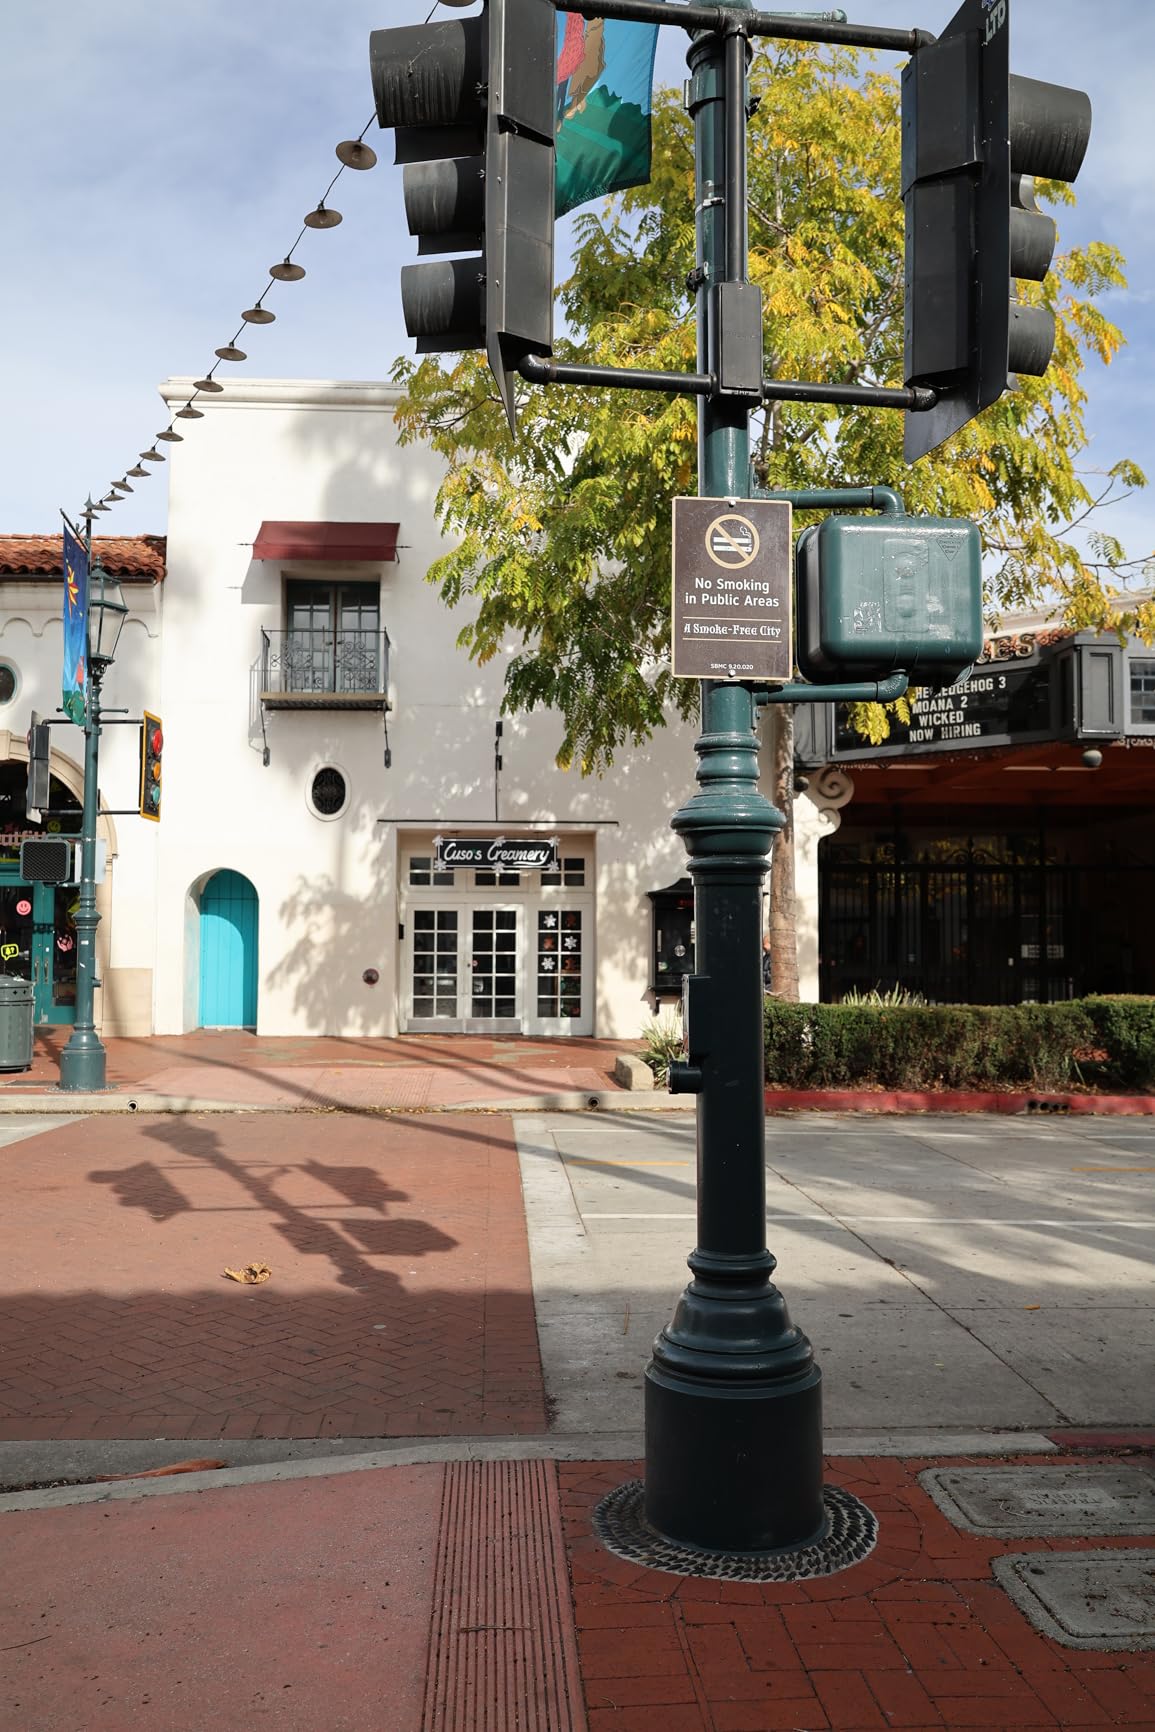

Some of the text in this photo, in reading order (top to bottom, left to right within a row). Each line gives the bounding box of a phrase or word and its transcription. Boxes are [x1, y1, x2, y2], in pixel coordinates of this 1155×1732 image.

[695, 577, 769, 594] No Smoking
[685, 592, 780, 607] in Public Areas
[684, 623, 781, 638] A Smoke-Free City
[998, 676, 1006, 689] 3
[912, 695, 968, 714] MOANA 2
[919, 710, 964, 727] WICKED
[909, 723, 981, 743] NOW HIRING
[487, 843, 550, 866] Creamery
